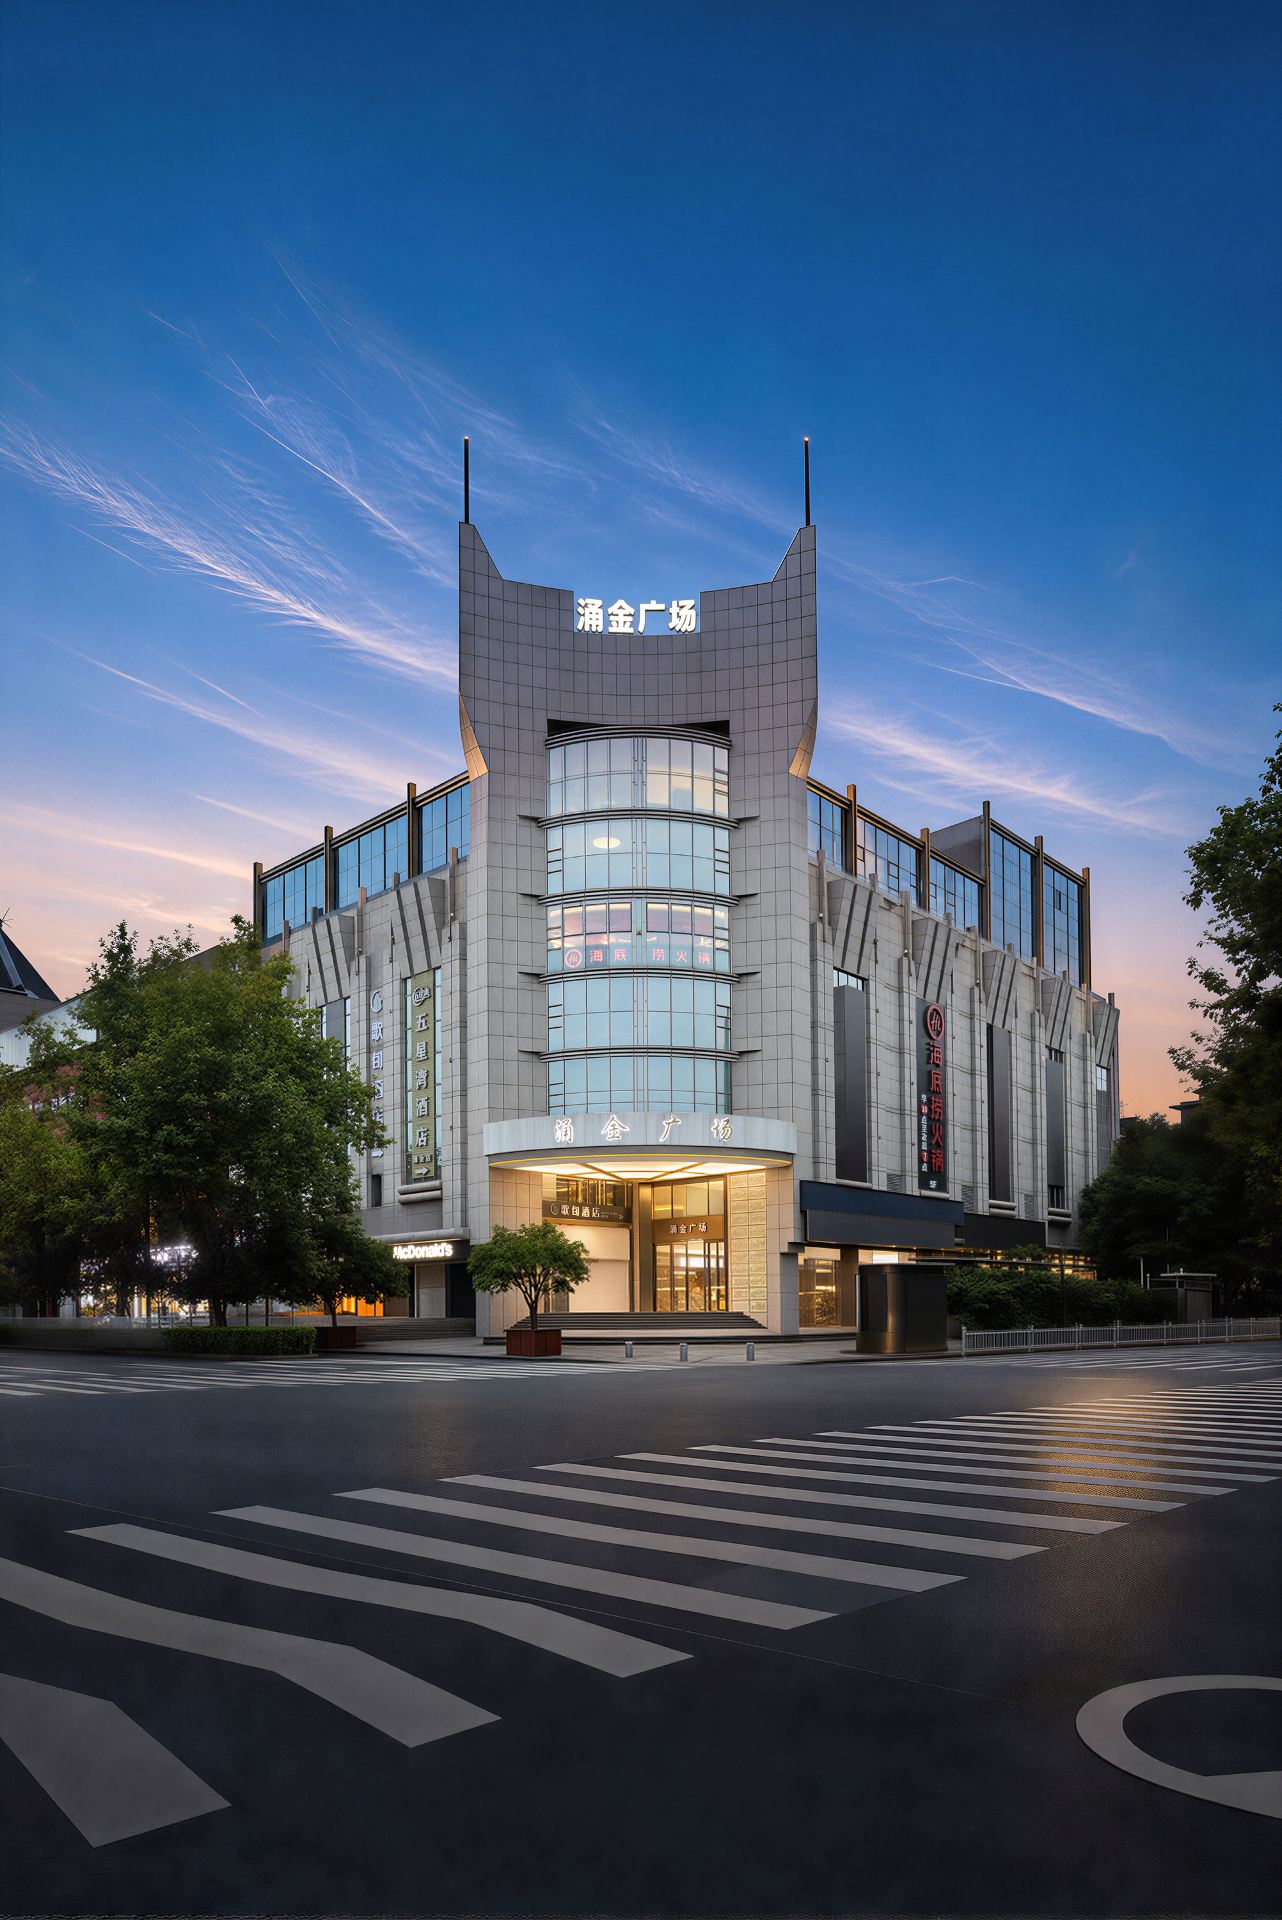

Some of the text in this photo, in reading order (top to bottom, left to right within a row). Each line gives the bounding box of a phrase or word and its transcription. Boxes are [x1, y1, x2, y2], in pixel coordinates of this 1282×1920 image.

[577, 598, 697, 633] 涌金广场
[589, 949, 710, 965] 海底捞火锅
[929, 1042, 944, 1172] 海底捞火锅
[554, 1115, 734, 1142] 涌金广场
[670, 1222, 707, 1234] 涌金广场
[393, 1243, 453, 1259] McDonald's
